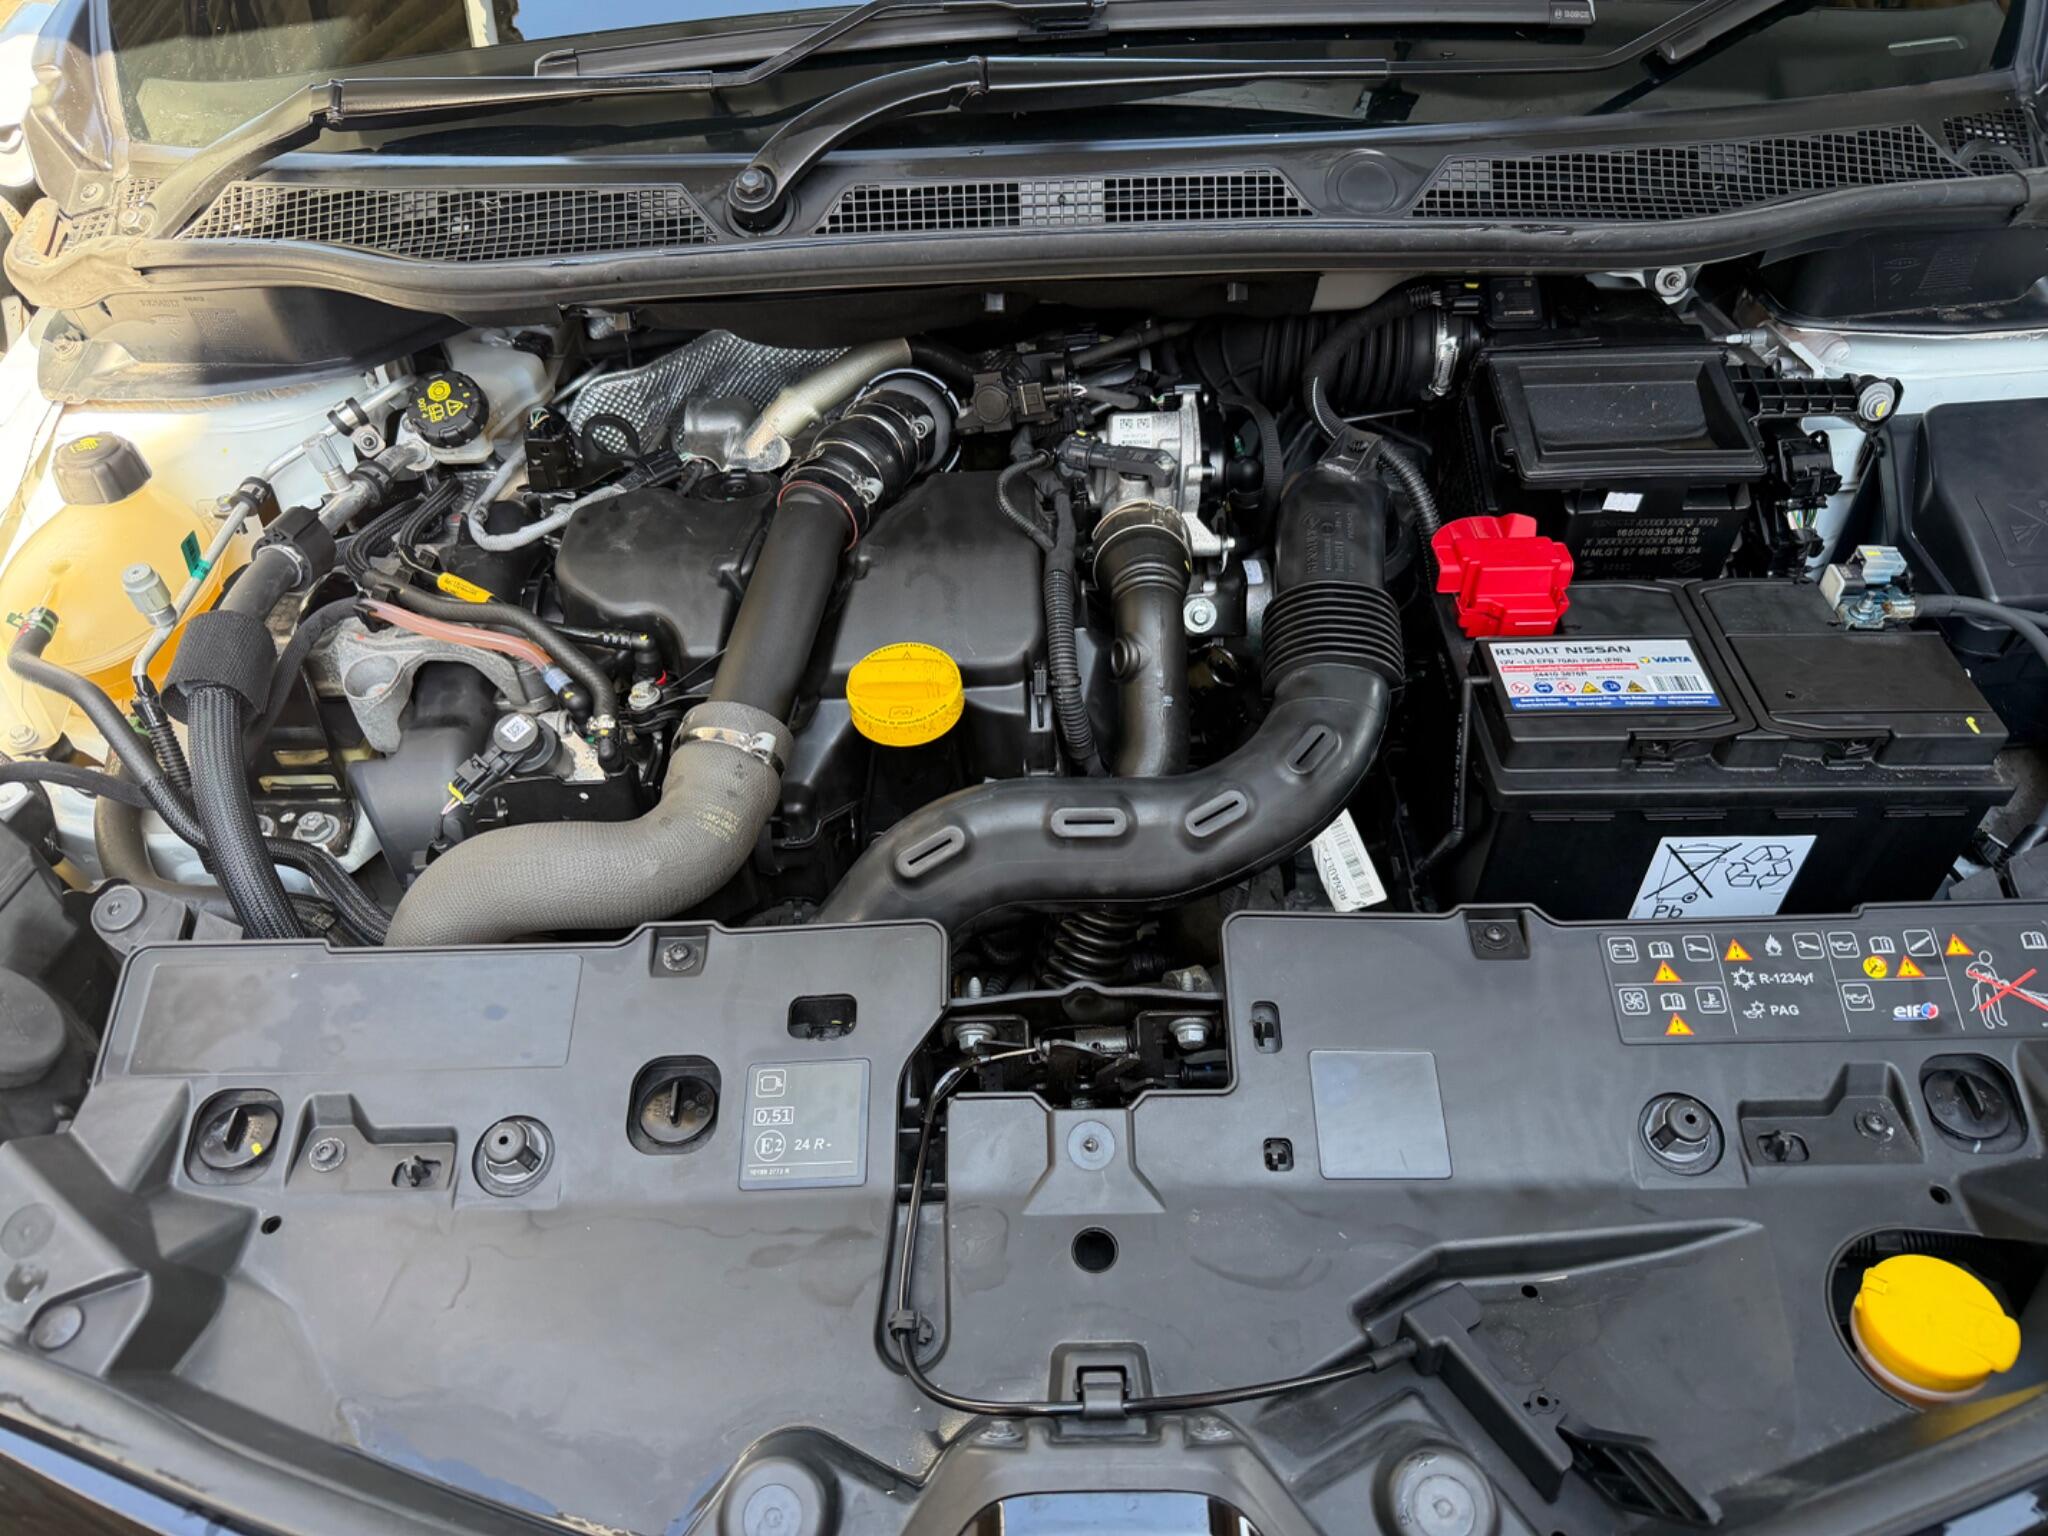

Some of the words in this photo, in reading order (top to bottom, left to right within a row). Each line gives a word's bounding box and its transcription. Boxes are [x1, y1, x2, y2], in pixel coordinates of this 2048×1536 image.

[1495, 646, 1560, 656] RENAULT
[1565, 645, 1632, 655] NISSAN
[1652, 656, 1692, 664] VARTA
[1323, 857, 1347, 901] RENAULT
[1651, 904, 1683, 919] Pb
[1759, 972, 1815, 986] R-1234yf
[1770, 1004, 1800, 1016] PAG
[1893, 1004, 1922, 1017] elf
[756, 1109, 791, 1124] 0,51
[760, 1137, 783, 1155] E2
[795, 1139, 811, 1151] 24
